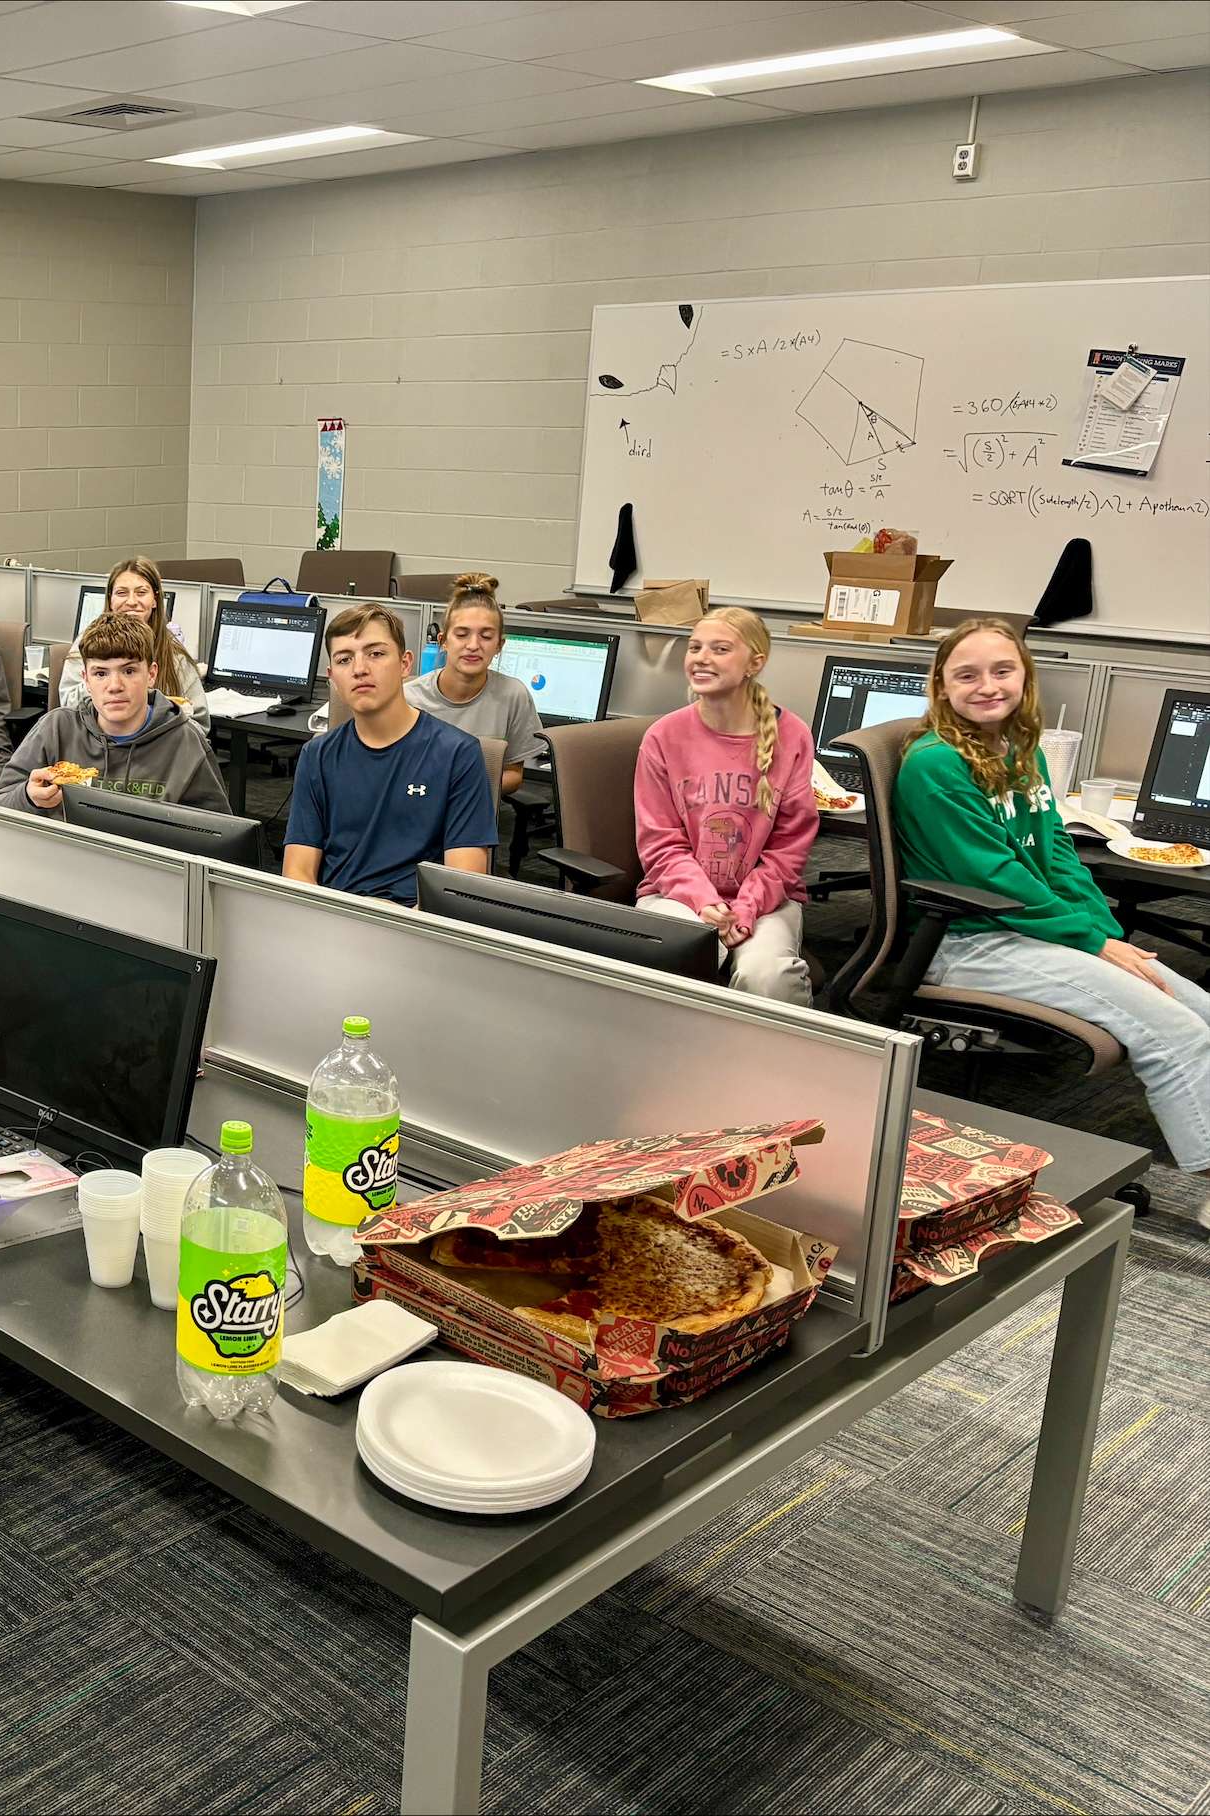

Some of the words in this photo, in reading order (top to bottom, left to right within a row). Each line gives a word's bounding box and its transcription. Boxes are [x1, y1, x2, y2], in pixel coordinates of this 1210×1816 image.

[1153, 359, 1179, 368] MARKS
[195, 960, 202, 973] 5
[345, 1149, 398, 1192] Star
[192, 1283, 283, 1337] Starry
[403, 1300, 431, 1321] previous
[219, 1334, 242, 1342] LEMON
[243, 1334, 258, 1342] LIME
[602, 1320, 637, 1345] MEAT
[603, 1326, 652, 1358] LOVER'S
[618, 1340, 650, 1362] MELT
[665, 1341, 690, 1358] No
[663, 1376, 688, 1392] No
